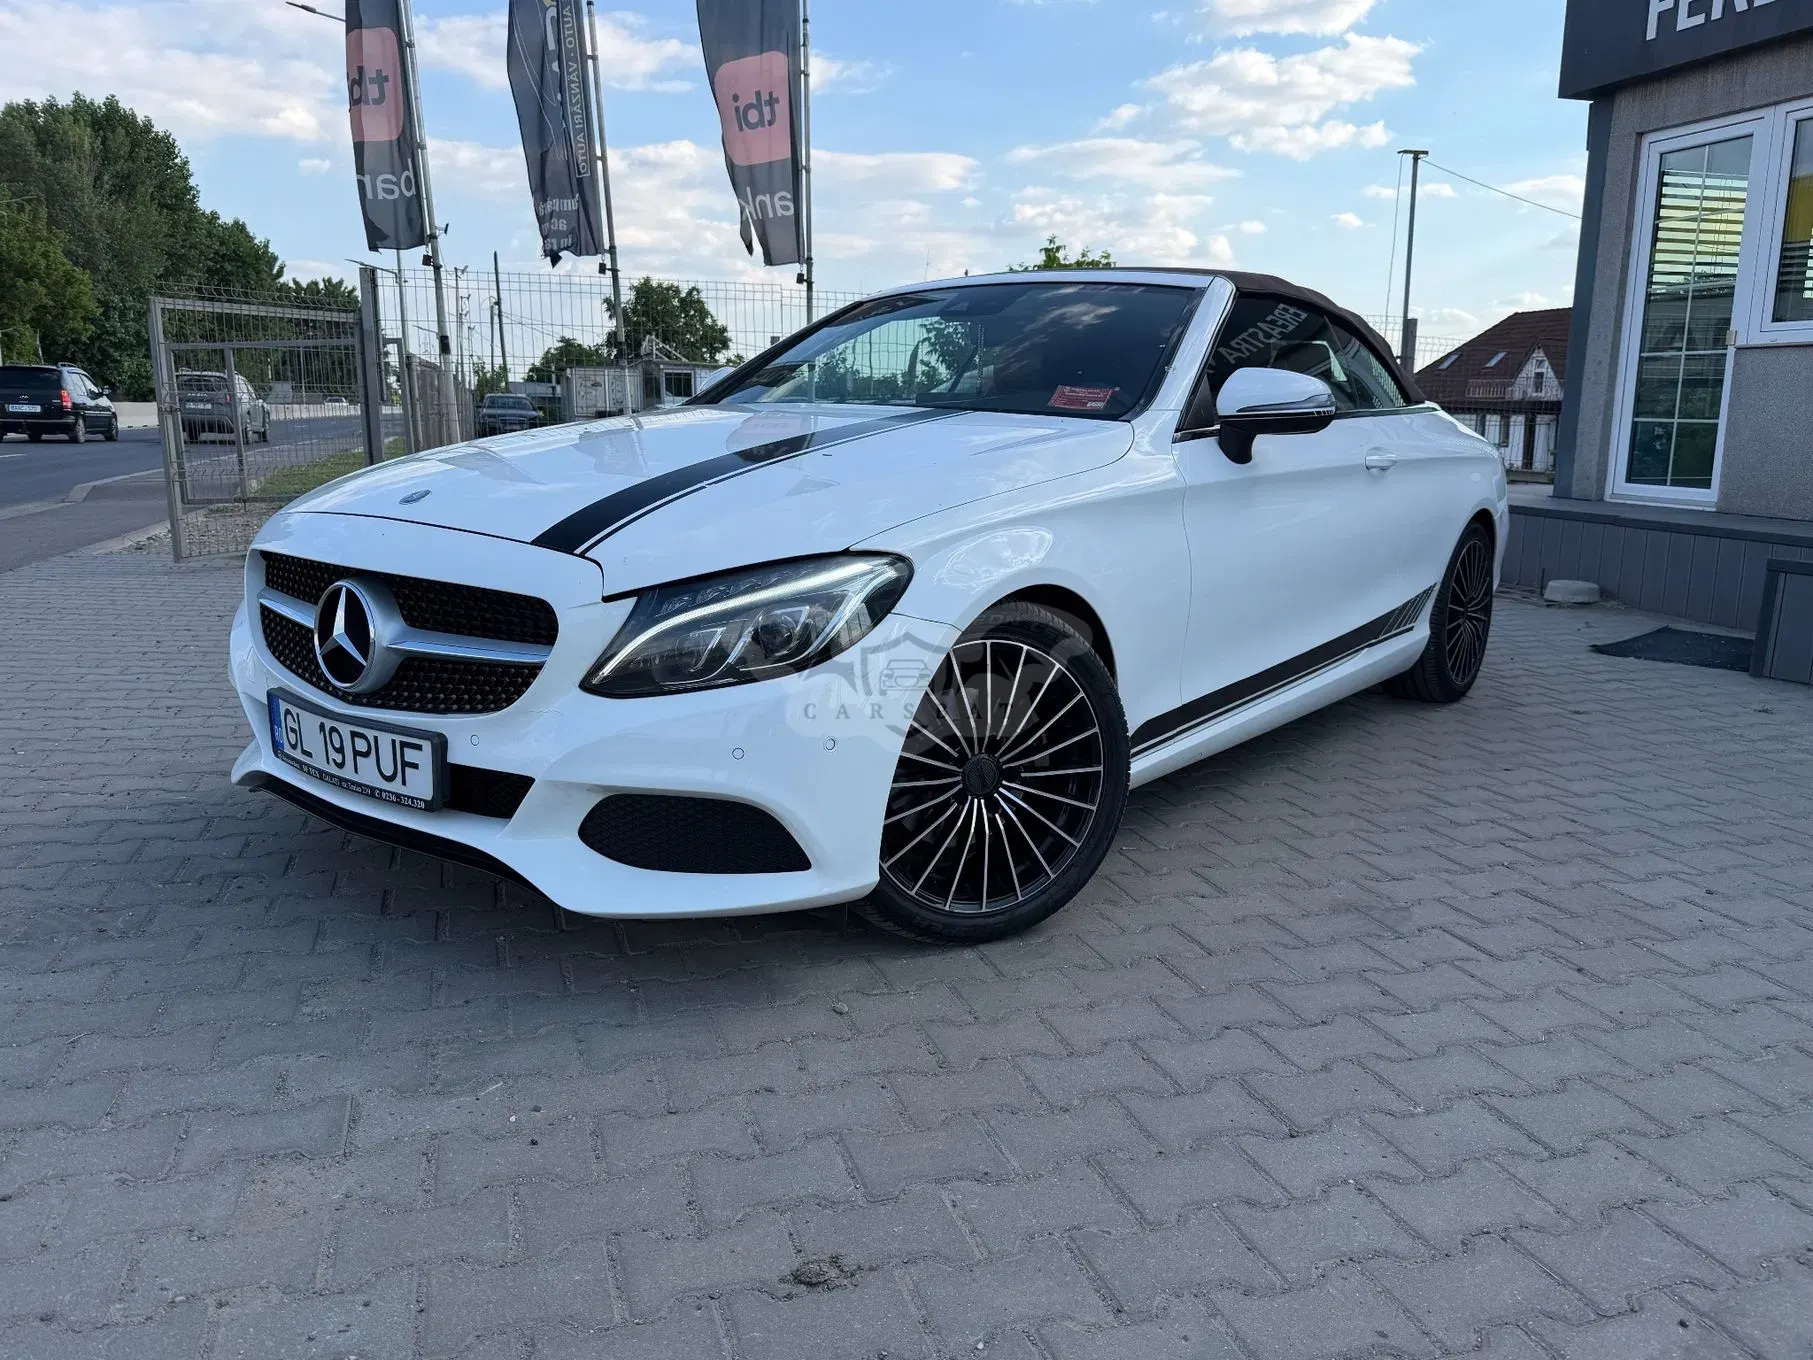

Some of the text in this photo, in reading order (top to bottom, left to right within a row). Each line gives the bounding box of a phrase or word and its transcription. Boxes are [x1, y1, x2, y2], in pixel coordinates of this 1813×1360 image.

[283, 707, 423, 786] GL 19 PUF
